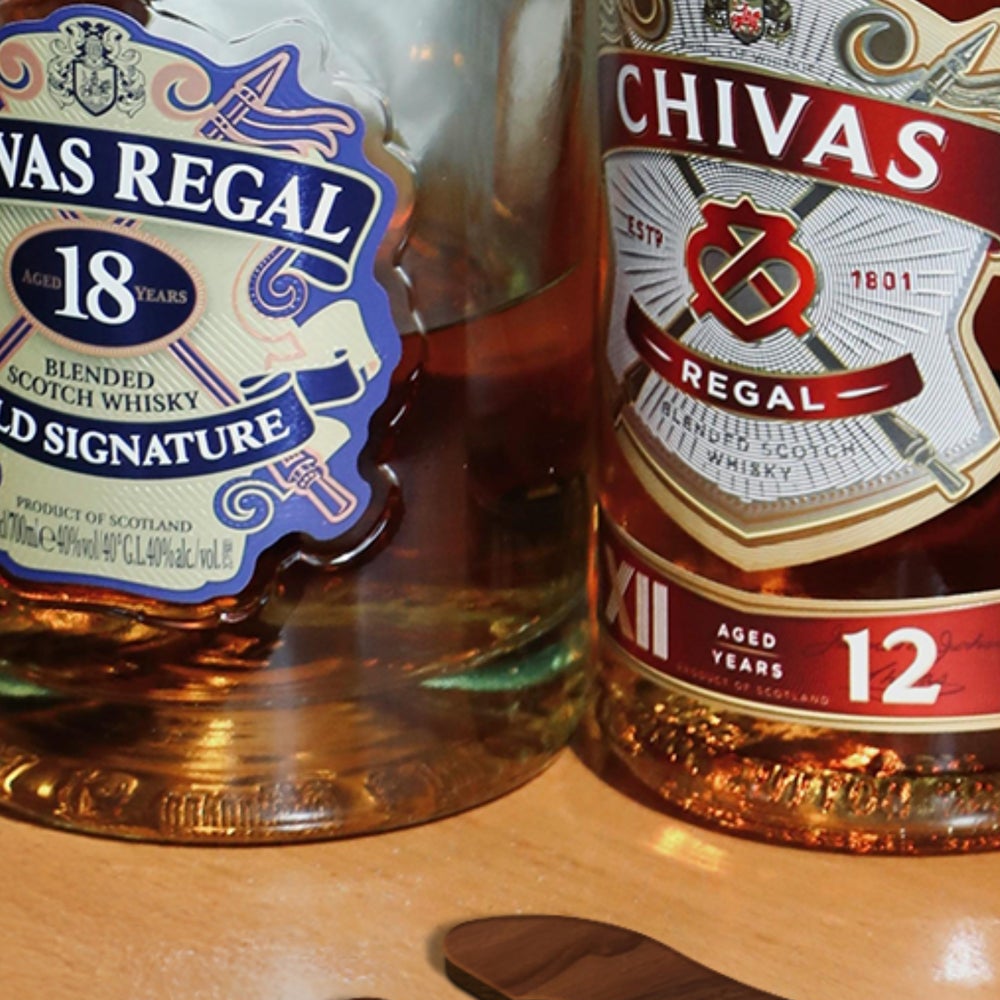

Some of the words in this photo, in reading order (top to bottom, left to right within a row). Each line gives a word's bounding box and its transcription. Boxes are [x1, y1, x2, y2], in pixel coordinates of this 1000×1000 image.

[617, 65, 947, 191] CHIVAS
[0, 132, 95, 196] VAS
[114, 141, 352, 244] REGAL
[22, 267, 61, 290] AGED
[54, 245, 136, 324] 18
[135, 285, 188, 305] YEARS
[851, 269, 911, 290] 1801
[7, 364, 94, 408] SCOTCH
[101, 391, 199, 413] WHISKY
[45, 358, 154, 389] BLENDED
[681, 359, 825, 412] REGAL
[43, 408, 290, 466] SIGNATURE
[661, 402, 749, 452] BLENDED
[761, 443, 856, 459] SCOTCH
[706, 450, 791, 480] WHISKY
[17, 496, 81, 521] PRODUCT
[85, 510, 104, 525] OF
[110, 516, 193, 533] SCOTLAND
[605, 545, 669, 661] XII
[717, 623, 776, 649] AGED
[711, 650, 784, 679] YEARS
[842, 627, 942, 705] 12
[756, 686, 829, 706] SCOTLAND
